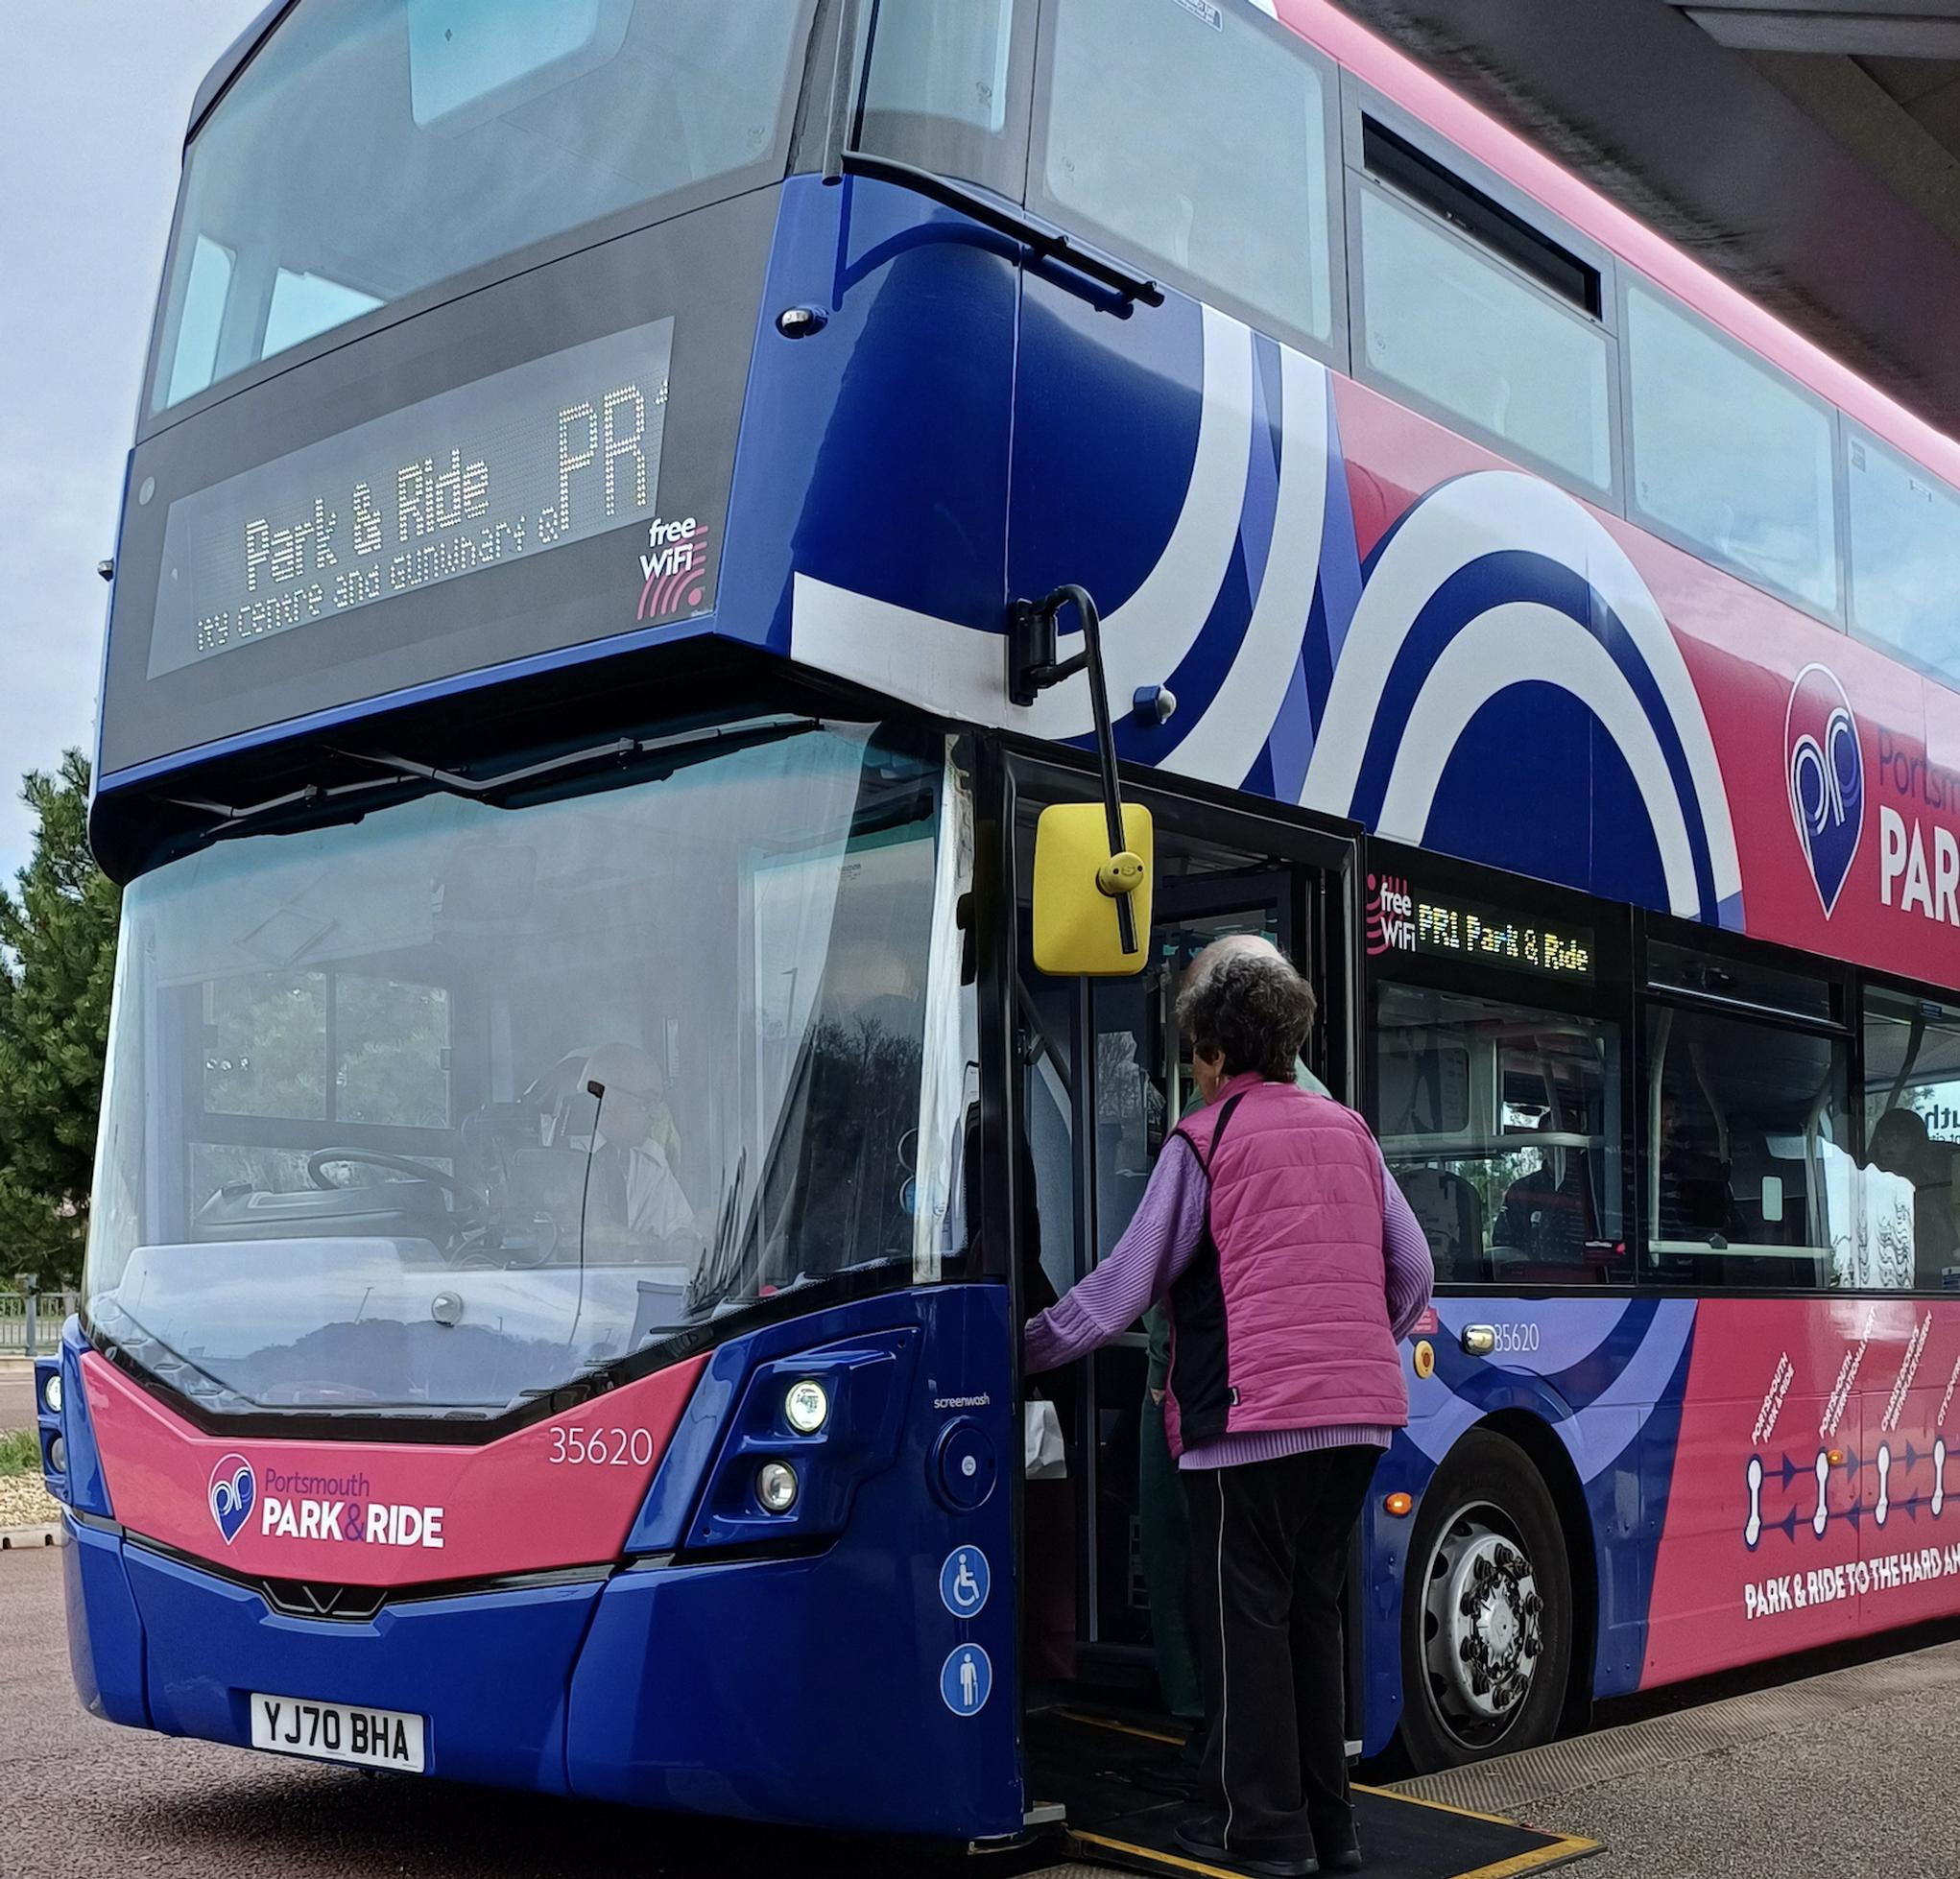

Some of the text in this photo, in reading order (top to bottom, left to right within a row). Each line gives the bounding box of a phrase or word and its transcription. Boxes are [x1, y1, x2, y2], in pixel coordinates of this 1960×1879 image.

[559, 379, 669, 530] PR
[246, 448, 490, 592] Park & Ride
[649, 517, 697, 548] free
[639, 543, 694, 582] WiFi
[237, 583, 323, 637] centre
[333, 563, 380, 608] and
[1879, 804, 1960, 929] PAR
[1379, 882, 1412, 916] free
[1379, 916, 1417, 953] WiFi
[1419, 903, 1589, 971] PR1 Park & Ride
[933, 1391, 991, 1410] screenwash
[1751, 1351, 1788, 1446] PORTSMOUTH
[548, 1426, 654, 1466] 35620
[265, 1467, 370, 1497] Portsmouth
[1744, 1575, 1793, 1620] PARK
[1794, 1573, 1807, 1608] &
[1806, 1564, 1846, 1605] RIDE
[1845, 1560, 1869, 1596] TO
[1869, 1555, 1900, 1591] THE
[1900, 1547, 1942, 1584] HARD
[264, 1701, 409, 1762] YJ70 BHA
